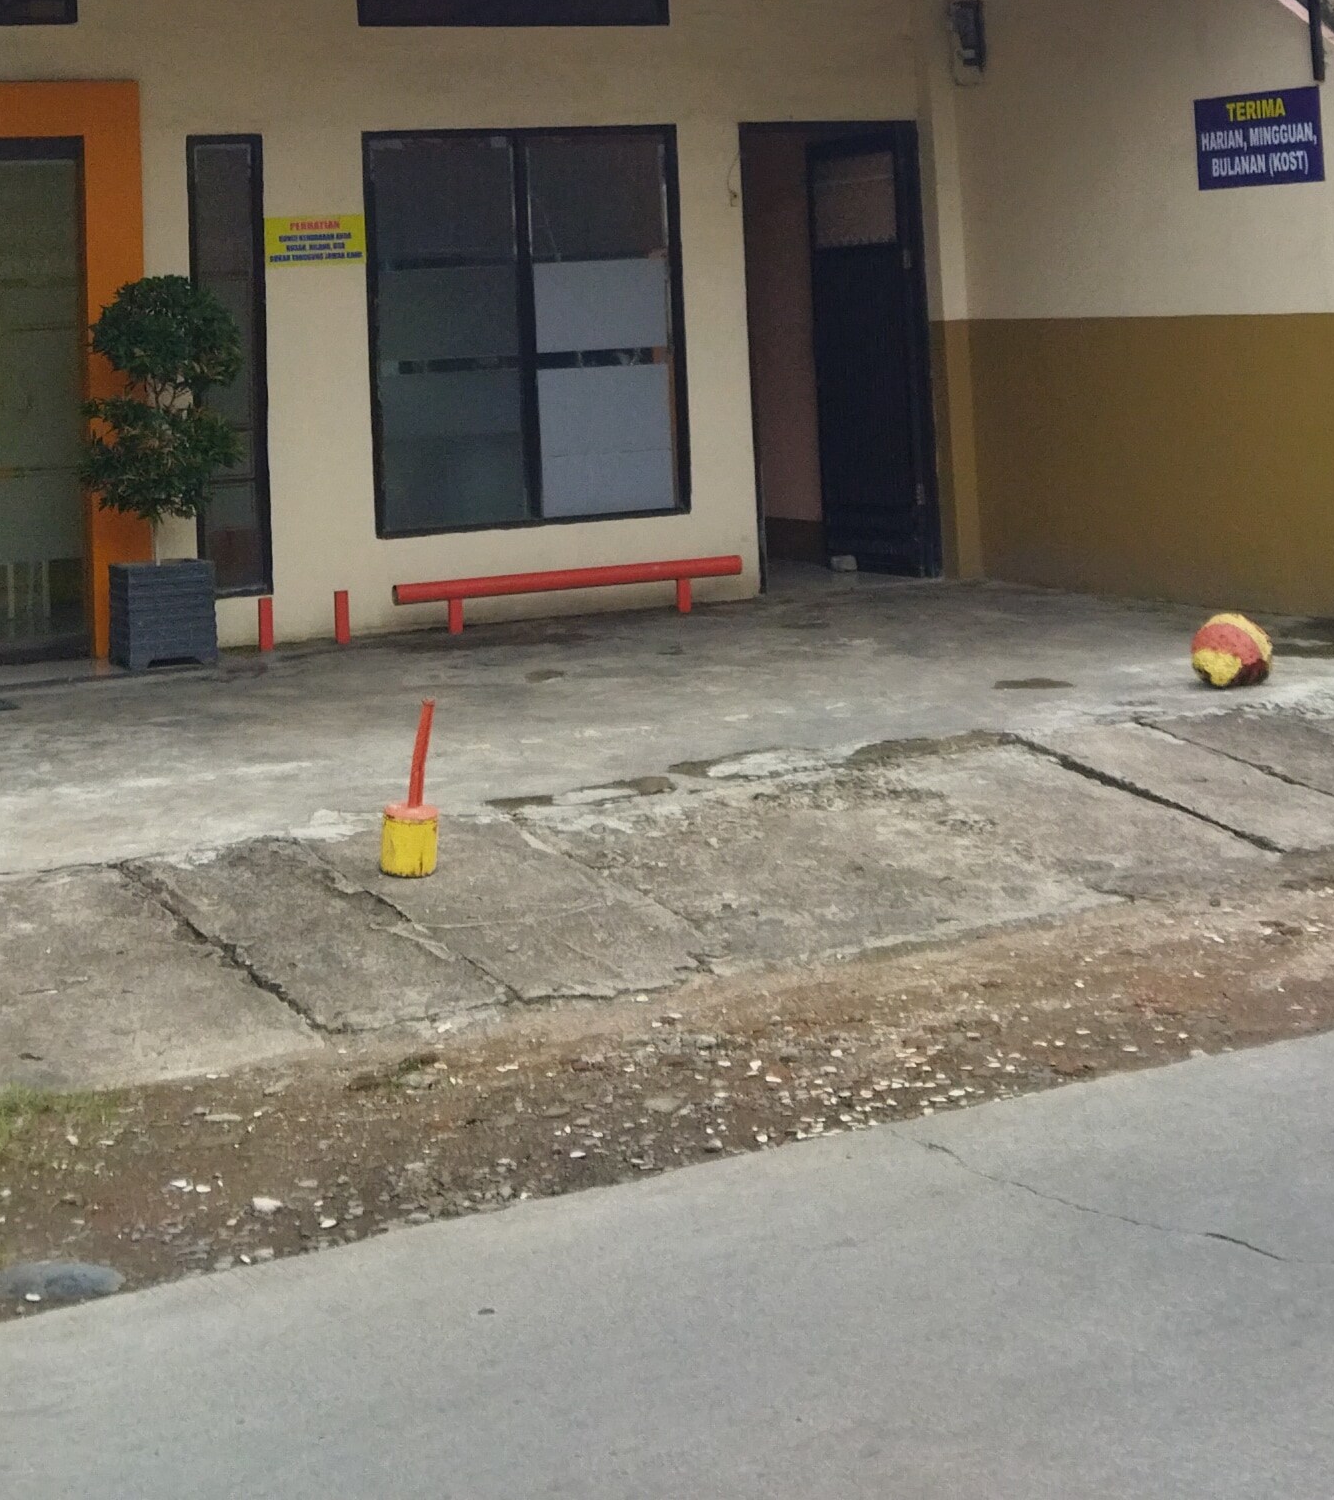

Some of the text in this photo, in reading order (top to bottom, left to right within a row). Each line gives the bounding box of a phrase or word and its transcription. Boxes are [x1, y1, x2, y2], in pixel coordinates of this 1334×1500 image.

[1226, 98, 1286, 122] TERIMA
[1201, 122, 1317, 151] HARIAN, MINGGUAN,
[1212, 150, 1309, 177] BULANAN (KOST)
